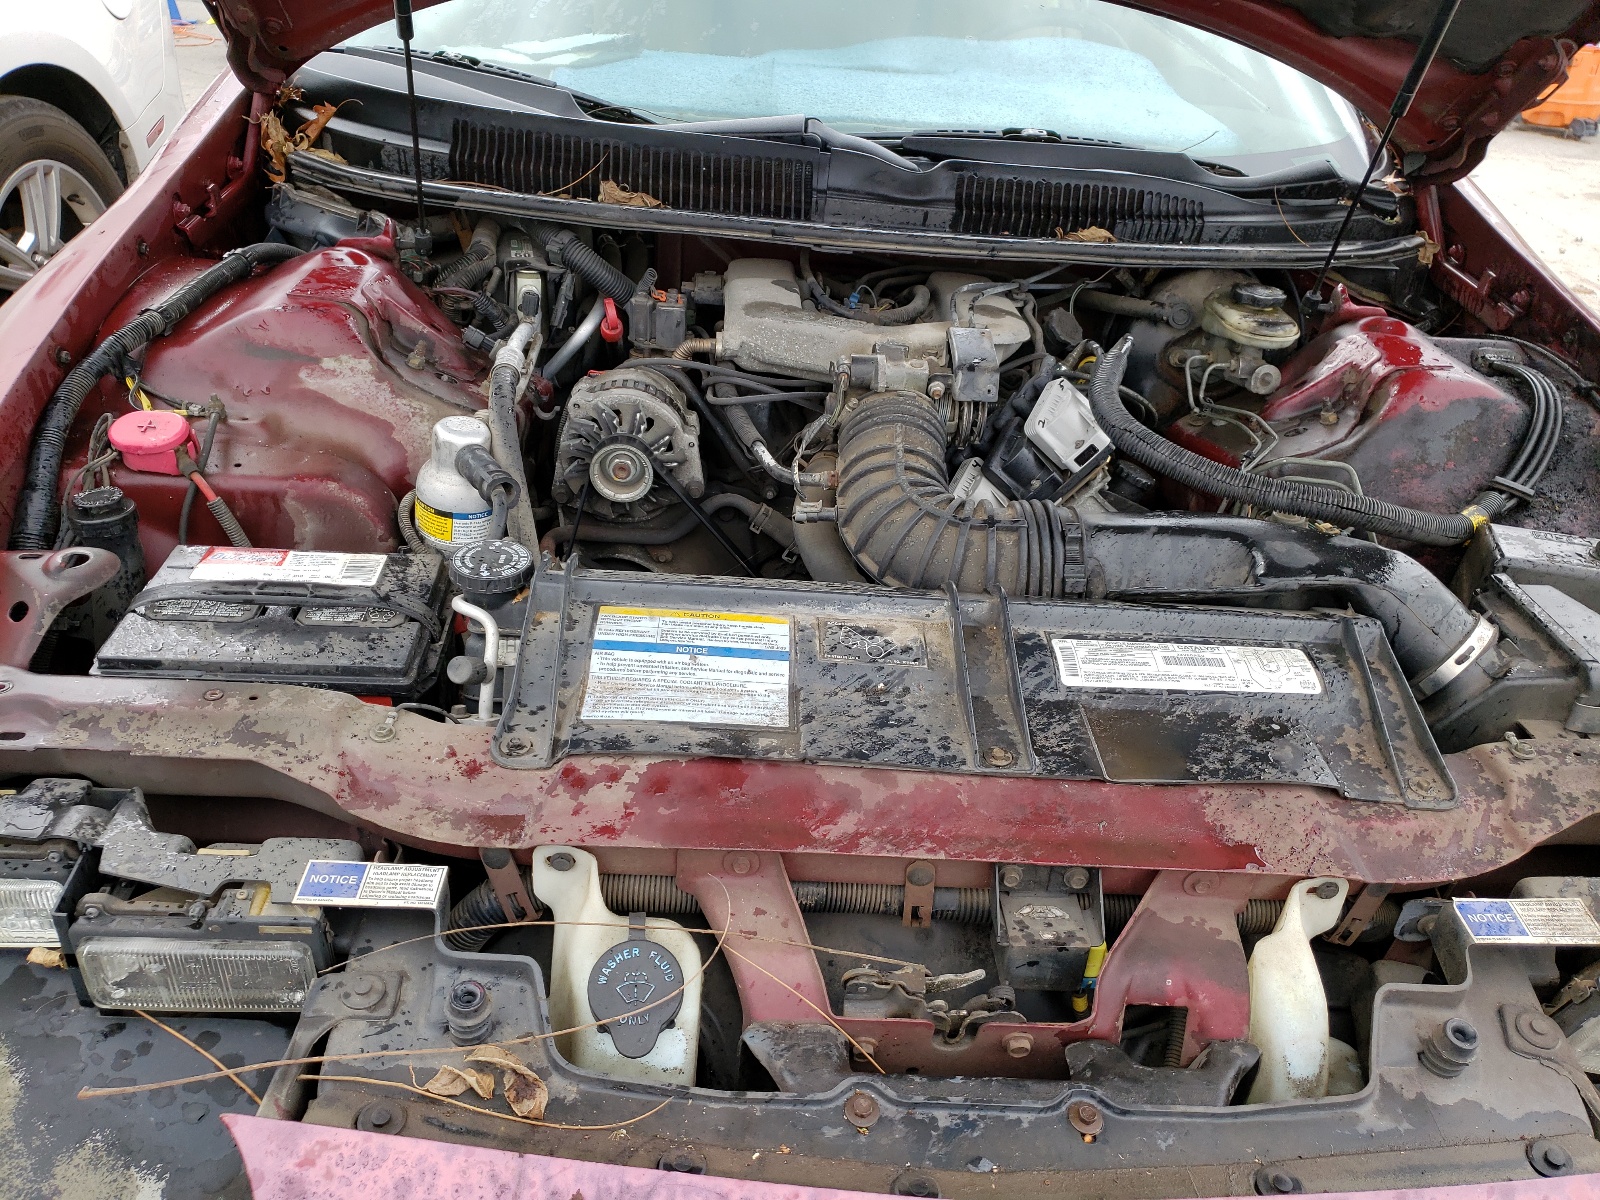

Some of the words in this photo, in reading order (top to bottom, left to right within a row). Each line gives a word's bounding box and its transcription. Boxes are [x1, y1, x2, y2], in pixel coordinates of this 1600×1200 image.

[1038, 419, 1046, 429] 2
[468, 511, 489, 520] NOTICE
[676, 646, 708, 654] NOTICE
[310, 874, 358, 884] NOTICE
[1466, 914, 1516, 922] NOTICE
[598, 948, 640, 985] WASHER
[648, 950, 675, 982] FLUID
[620, 1013, 650, 1026] ONLY
